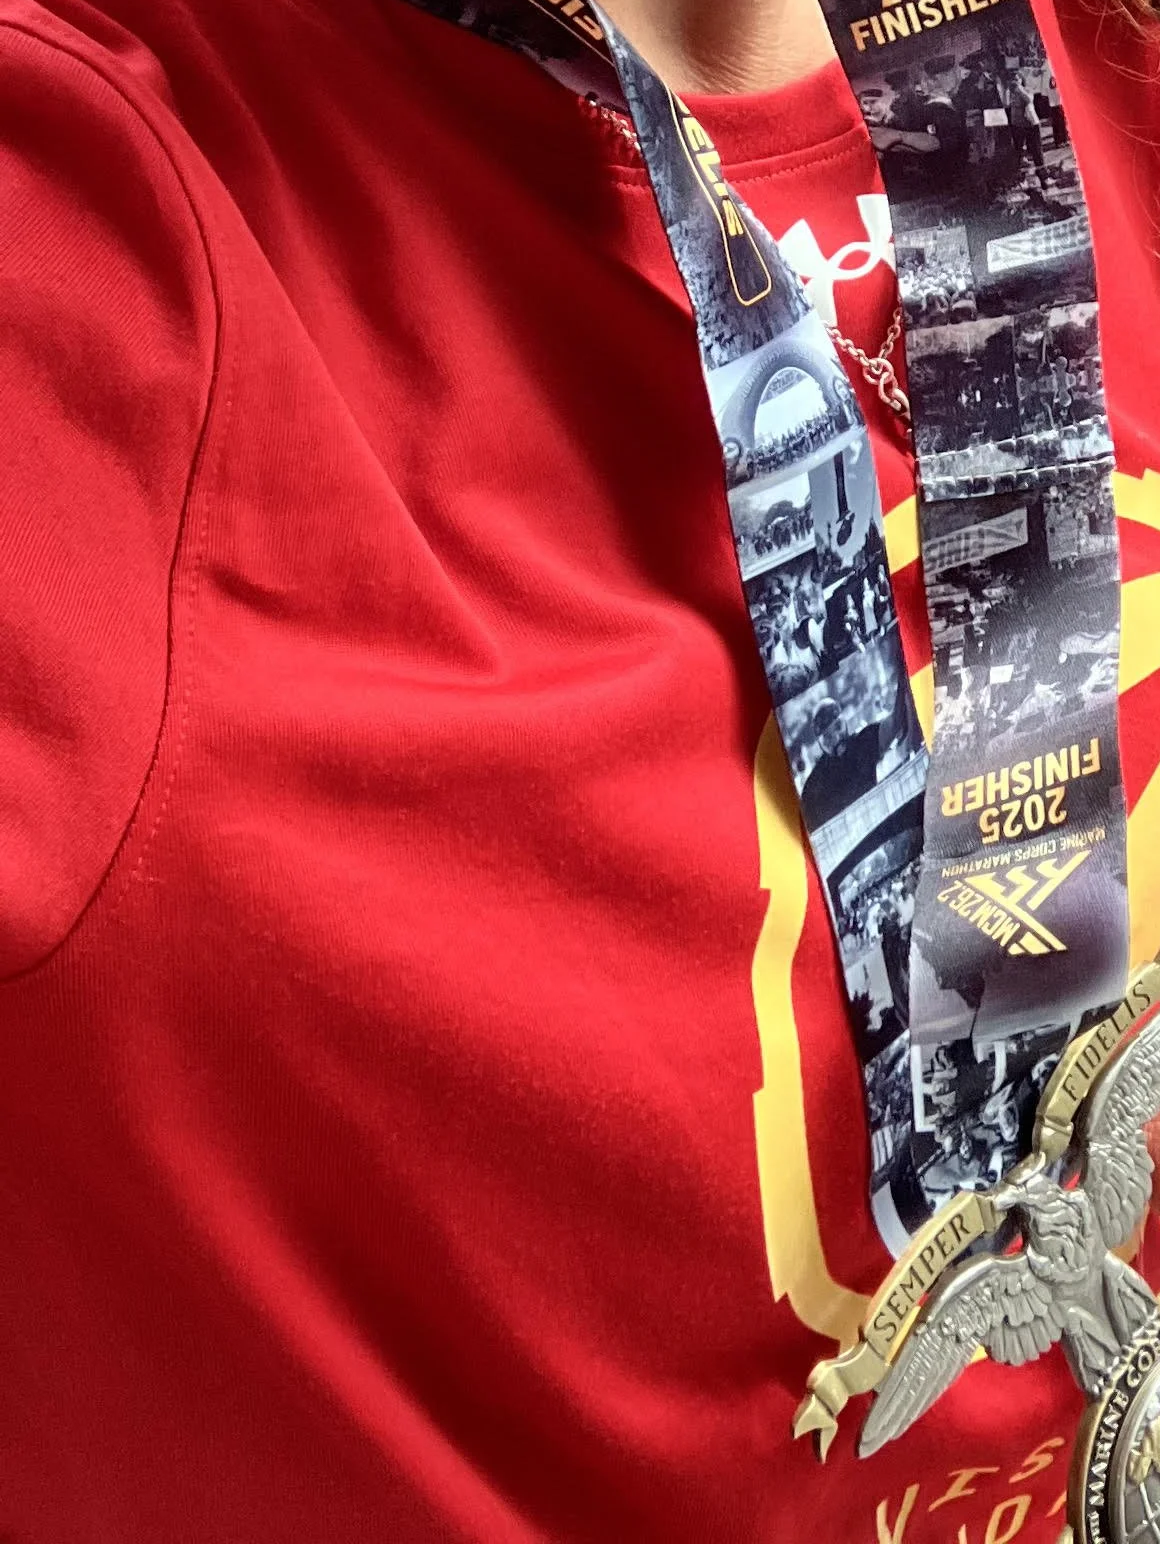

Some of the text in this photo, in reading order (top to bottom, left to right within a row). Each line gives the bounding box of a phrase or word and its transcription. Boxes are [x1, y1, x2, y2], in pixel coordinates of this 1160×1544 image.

[941, 737, 1101, 817] FINISHER
[979, 786, 1068, 845] 2025
[941, 825, 1106, 879] MARINE CORPS MARATHON
[1062, 979, 1151, 1102] FIDELIS
[873, 1213, 970, 1343] SEMPER
[1088, 1388, 1130, 1506] MARINE
